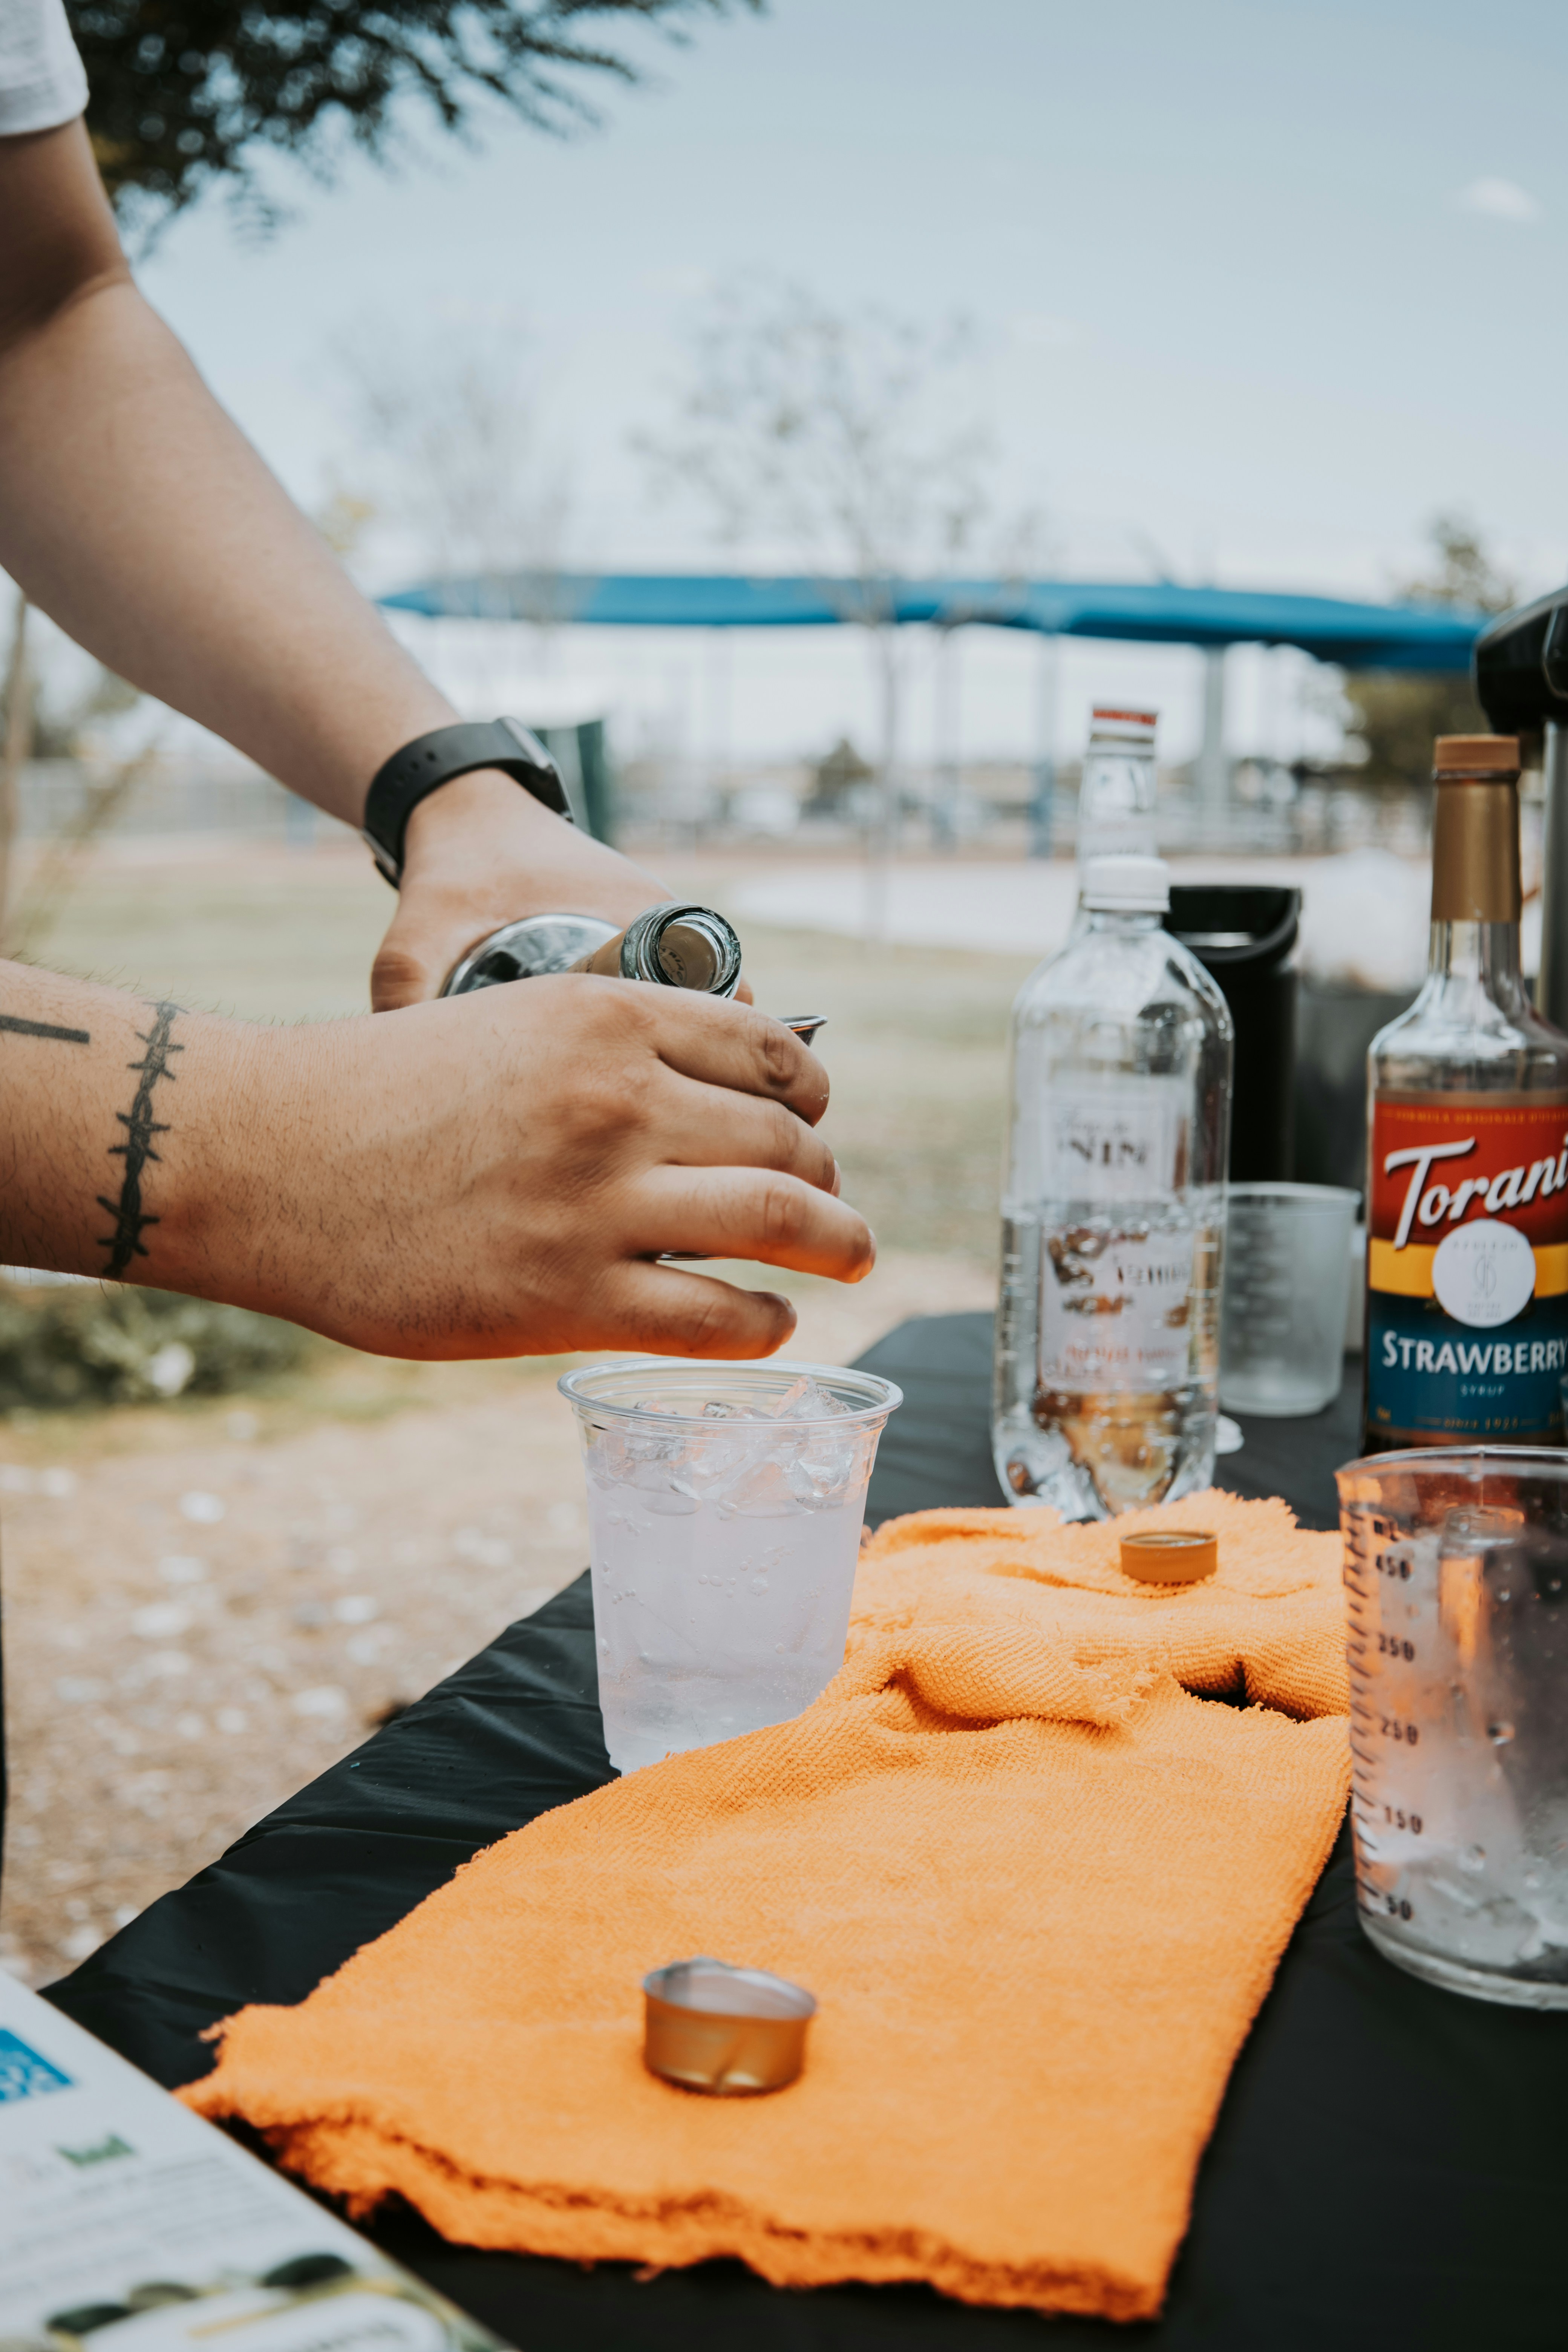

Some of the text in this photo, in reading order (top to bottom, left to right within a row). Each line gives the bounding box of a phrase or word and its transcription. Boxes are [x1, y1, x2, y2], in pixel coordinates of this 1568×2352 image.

[1384, 1135, 1568, 1250] Torani
[1382, 1329, 1568, 1375] STRAWBERRY
[1382, 1715, 1419, 1746] 250
[1385, 1806, 1423, 1835] 150
[1386, 1893, 1413, 1921] 50
